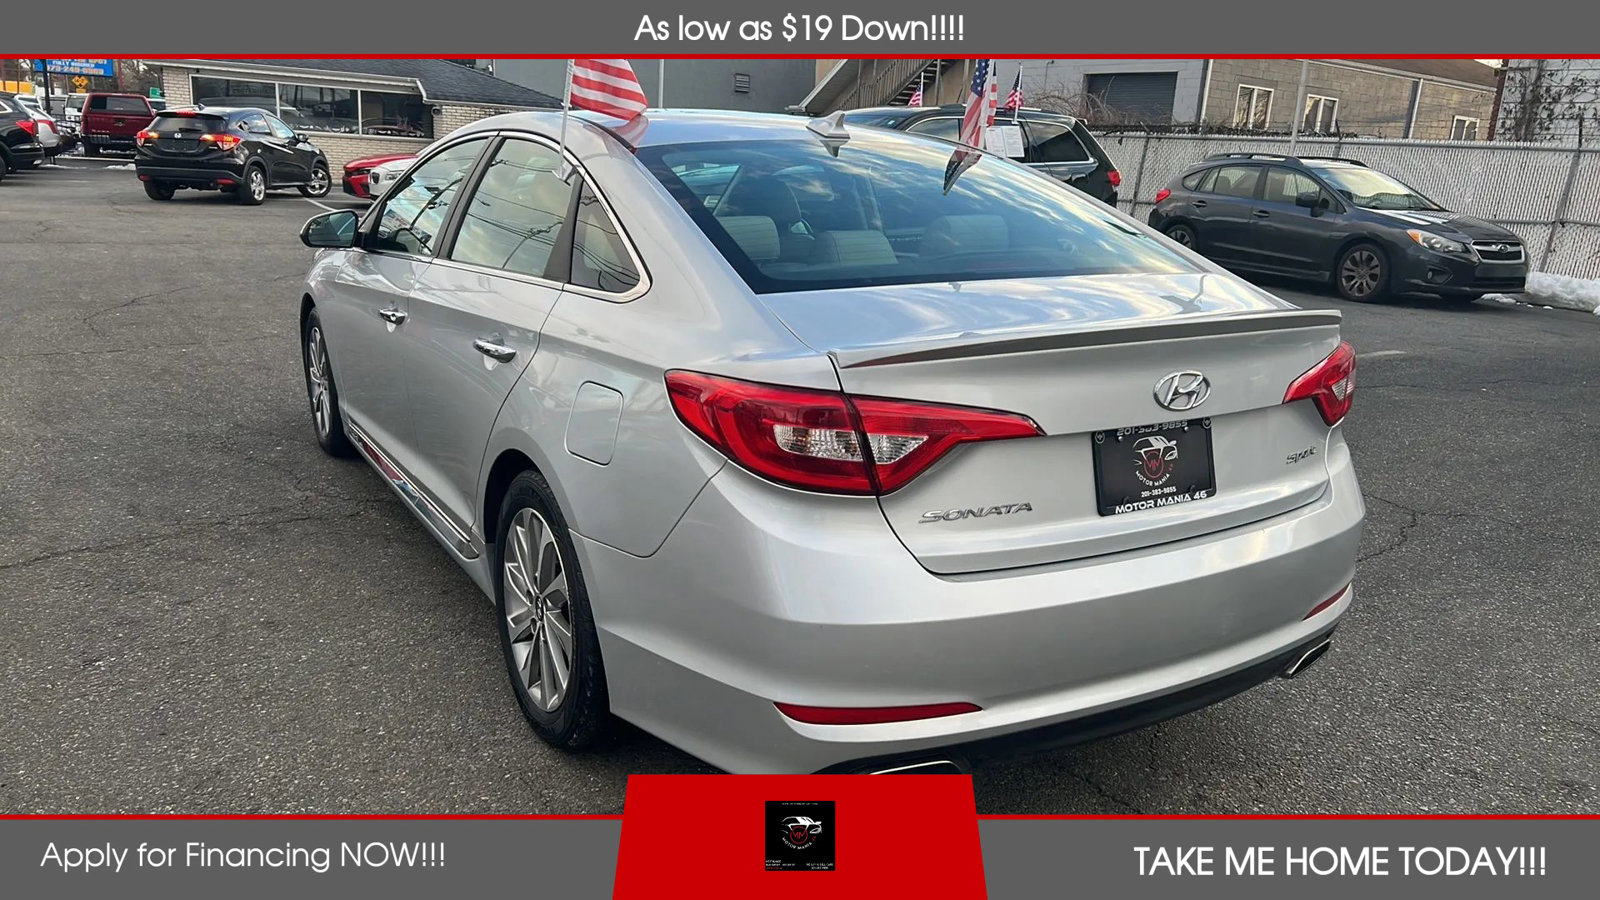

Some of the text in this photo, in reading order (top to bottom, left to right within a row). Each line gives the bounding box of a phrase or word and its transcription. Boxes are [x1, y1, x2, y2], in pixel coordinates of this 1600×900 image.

[1135, 470, 1170, 487] MOTOR MANIA
[918, 502, 1033, 523] SONATA
[1115, 490, 1208, 515] MOTOR MANIA 46
